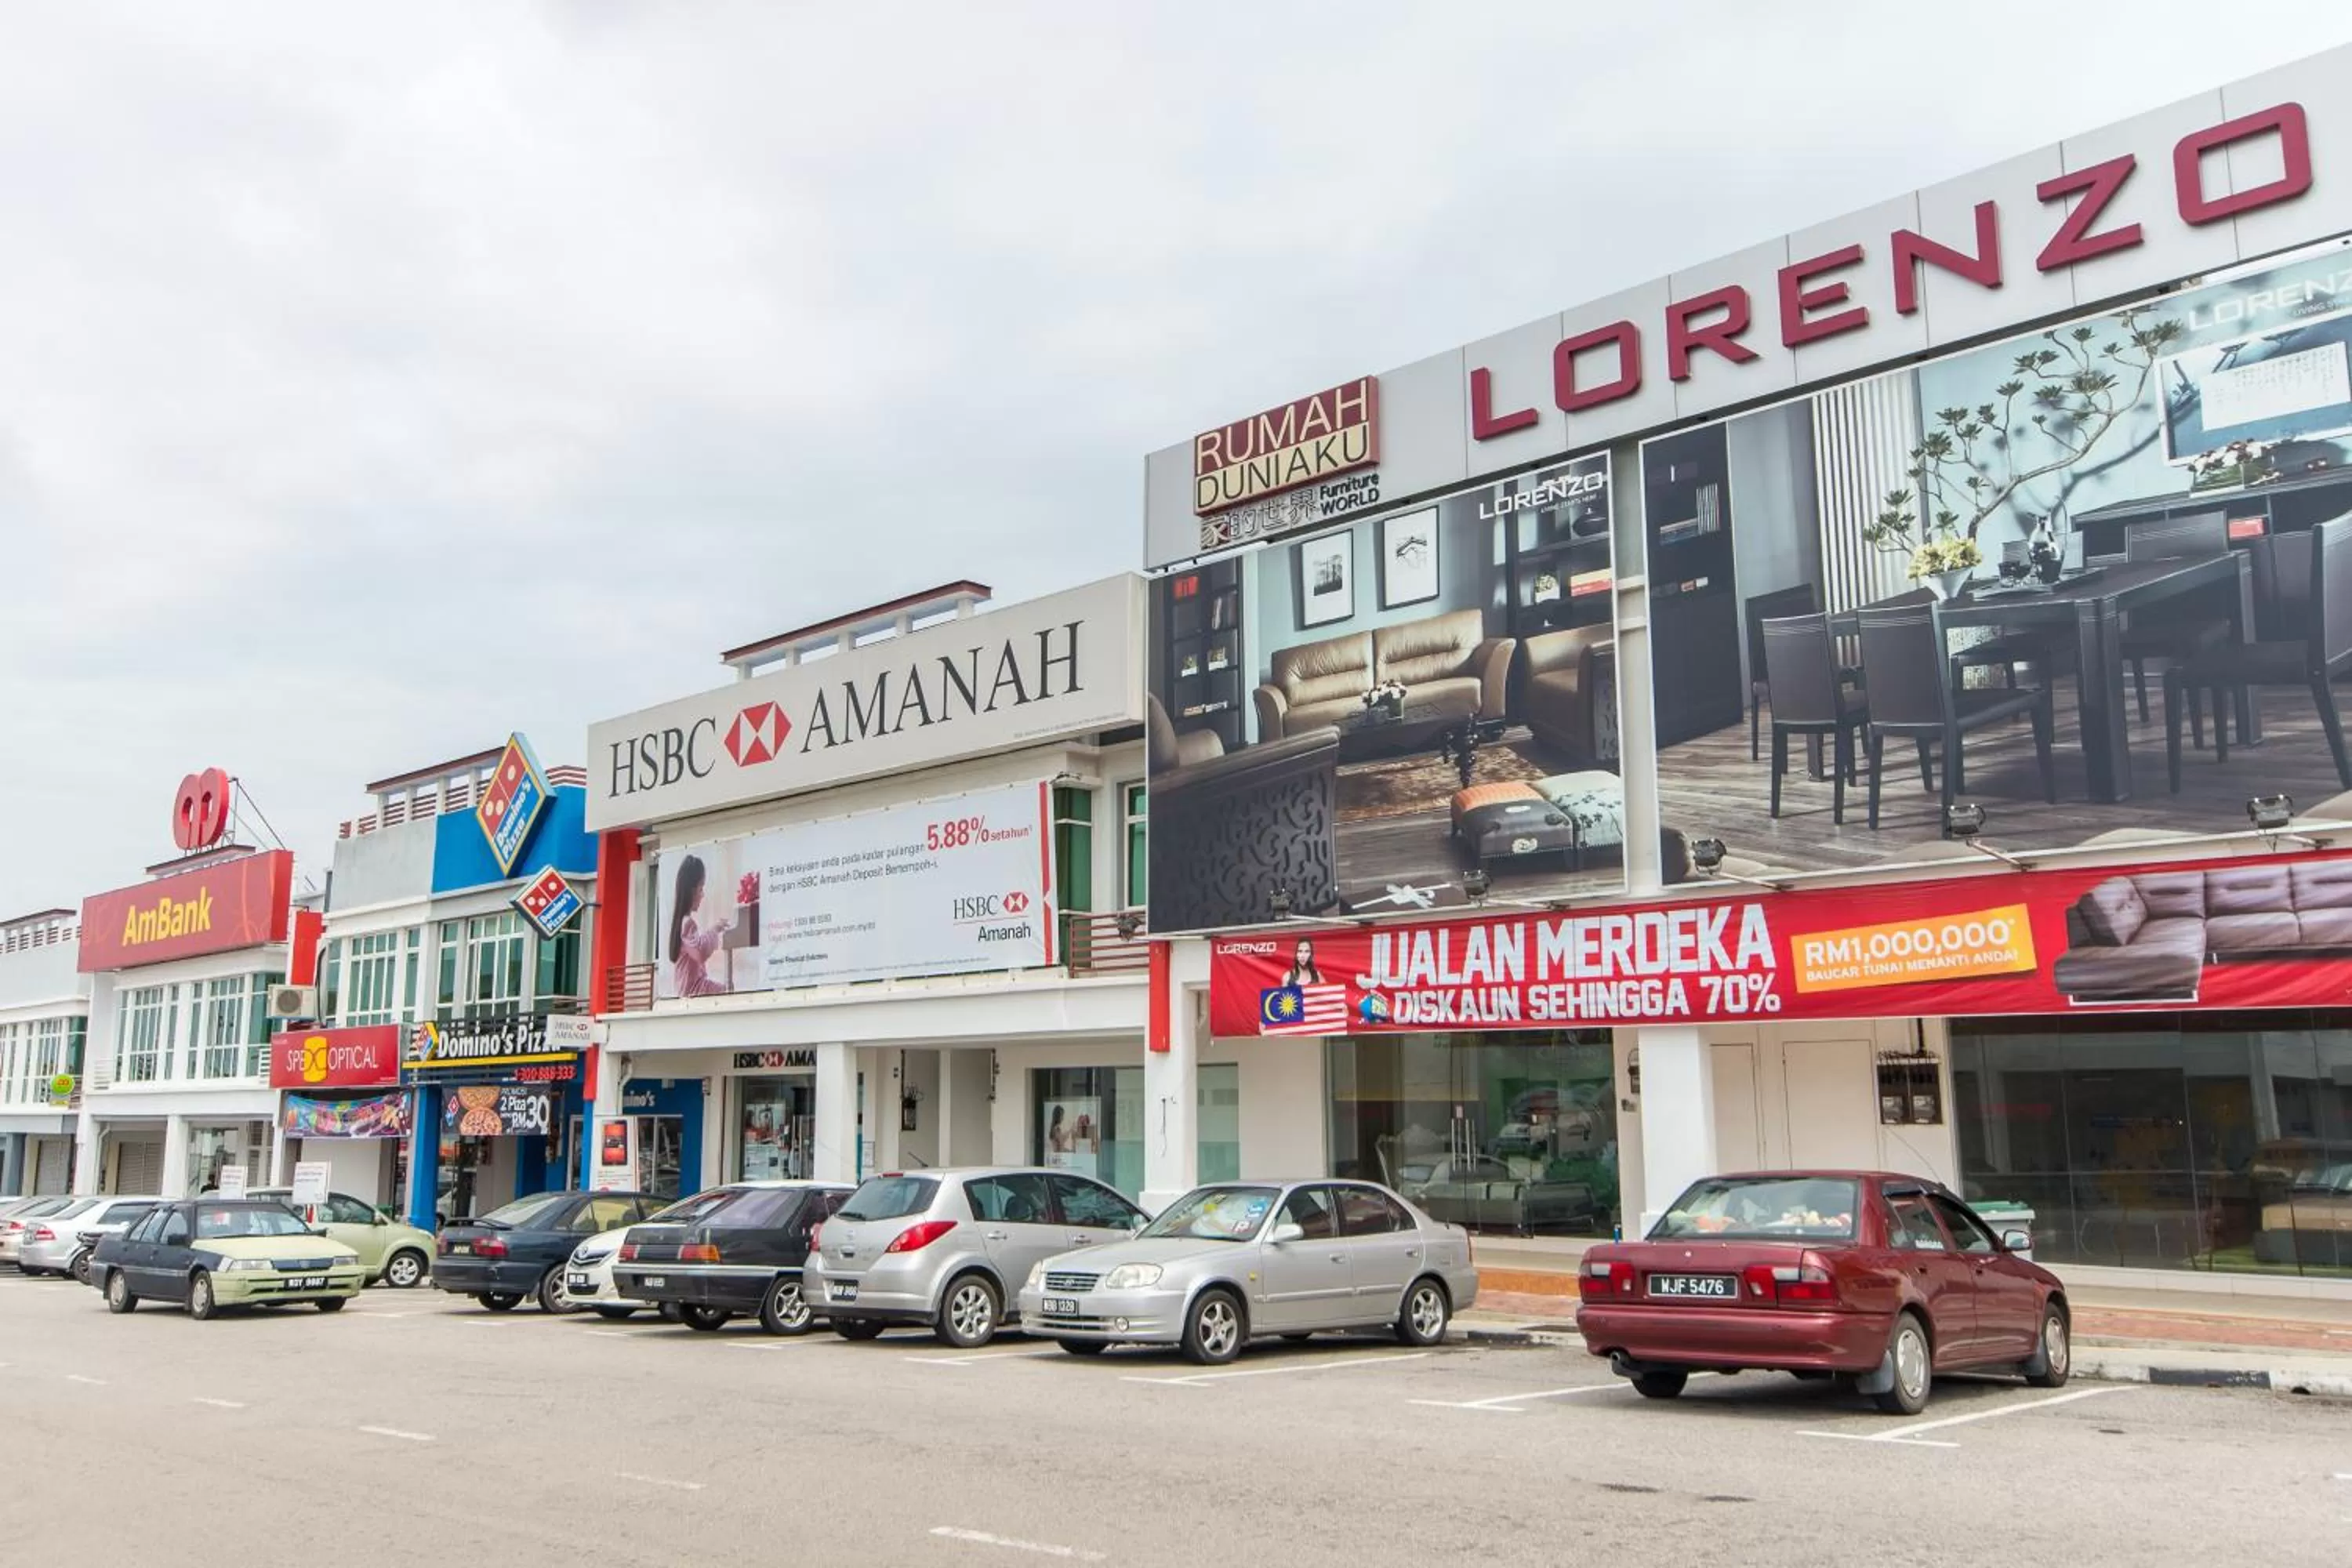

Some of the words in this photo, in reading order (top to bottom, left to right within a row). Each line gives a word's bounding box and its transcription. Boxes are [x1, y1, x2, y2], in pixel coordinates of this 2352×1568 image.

[1469, 100, 2313, 441] LORENZO
[1196, 379, 1368, 475] RUMAH
[1196, 424, 1368, 509] DUNIAKU
[1319, 472, 1379, 500] Furniture
[1320, 488, 1380, 516] WORLD
[1479, 471, 1603, 520] LORENZO
[608, 717, 717, 799] HSBC
[800, 619, 1085, 754] AMANAH
[496, 780, 532, 848] Domino's
[503, 816, 525, 862] Pizza
[927, 815, 989, 851] 5.88%
[122, 886, 213, 947] AmBank
[539, 894, 572, 924] Domino's
[953, 895, 999, 920] HSBC
[978, 922, 1032, 942] Amanah
[1216, 942, 1277, 954] LORENZO
[1356, 923, 1525, 989] JUALAN
[1537, 903, 1776, 982] MERDEKA
[1807, 967, 1858, 982] BAUCAR
[1863, 962, 1904, 975] TUNAI
[1906, 956, 1969, 973] MENANTI
[1393, 986, 1521, 1025] DISKAUN
[1529, 978, 1690, 1021] SEHINGGA
[1699, 971, 1781, 1014] 70%
[328, 1044, 379, 1071] OPTICAL
[437, 1025, 514, 1058] Domino's
[733, 1051, 765, 1069] HSBC
[500, 1097, 507, 1111] 2
[1661, 1279, 1686, 1294] WJF
[1690, 1279, 1725, 1294] 5476
